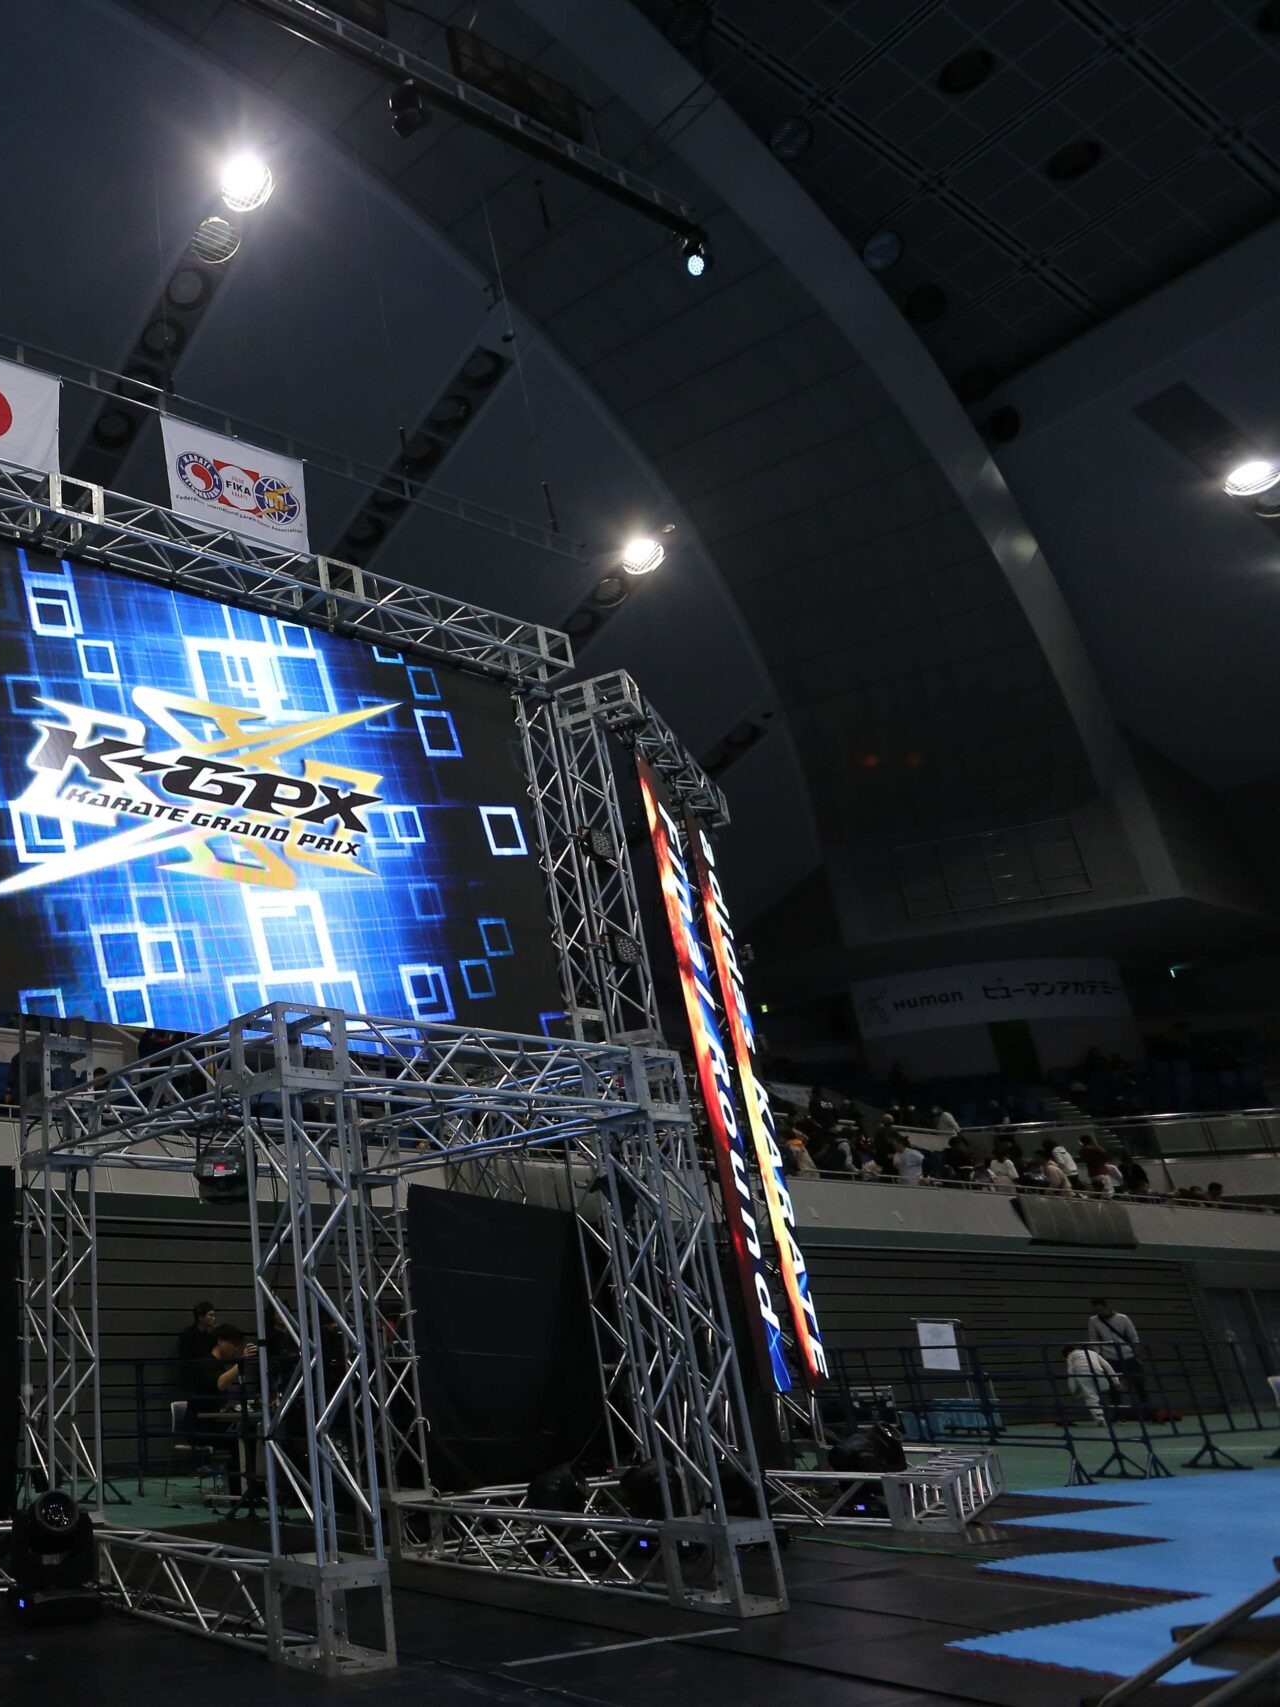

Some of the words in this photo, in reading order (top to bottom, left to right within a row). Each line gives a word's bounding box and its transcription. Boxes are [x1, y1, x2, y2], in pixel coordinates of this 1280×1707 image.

[225, 479, 252, 497] FIKA
[31, 723, 384, 833] K-GPX
[65, 788, 188, 823] KARATE
[190, 813, 292, 843] GRAND
[297, 833, 362, 857] PRIX
[982, 979, 1122, 1000] ヒューマンアカデミー
[658, 801, 716, 1011] Final
[705, 1030, 781, 1332] Round
[699, 829, 756, 1055] adidas
[752, 1075, 830, 1380] KARATE
